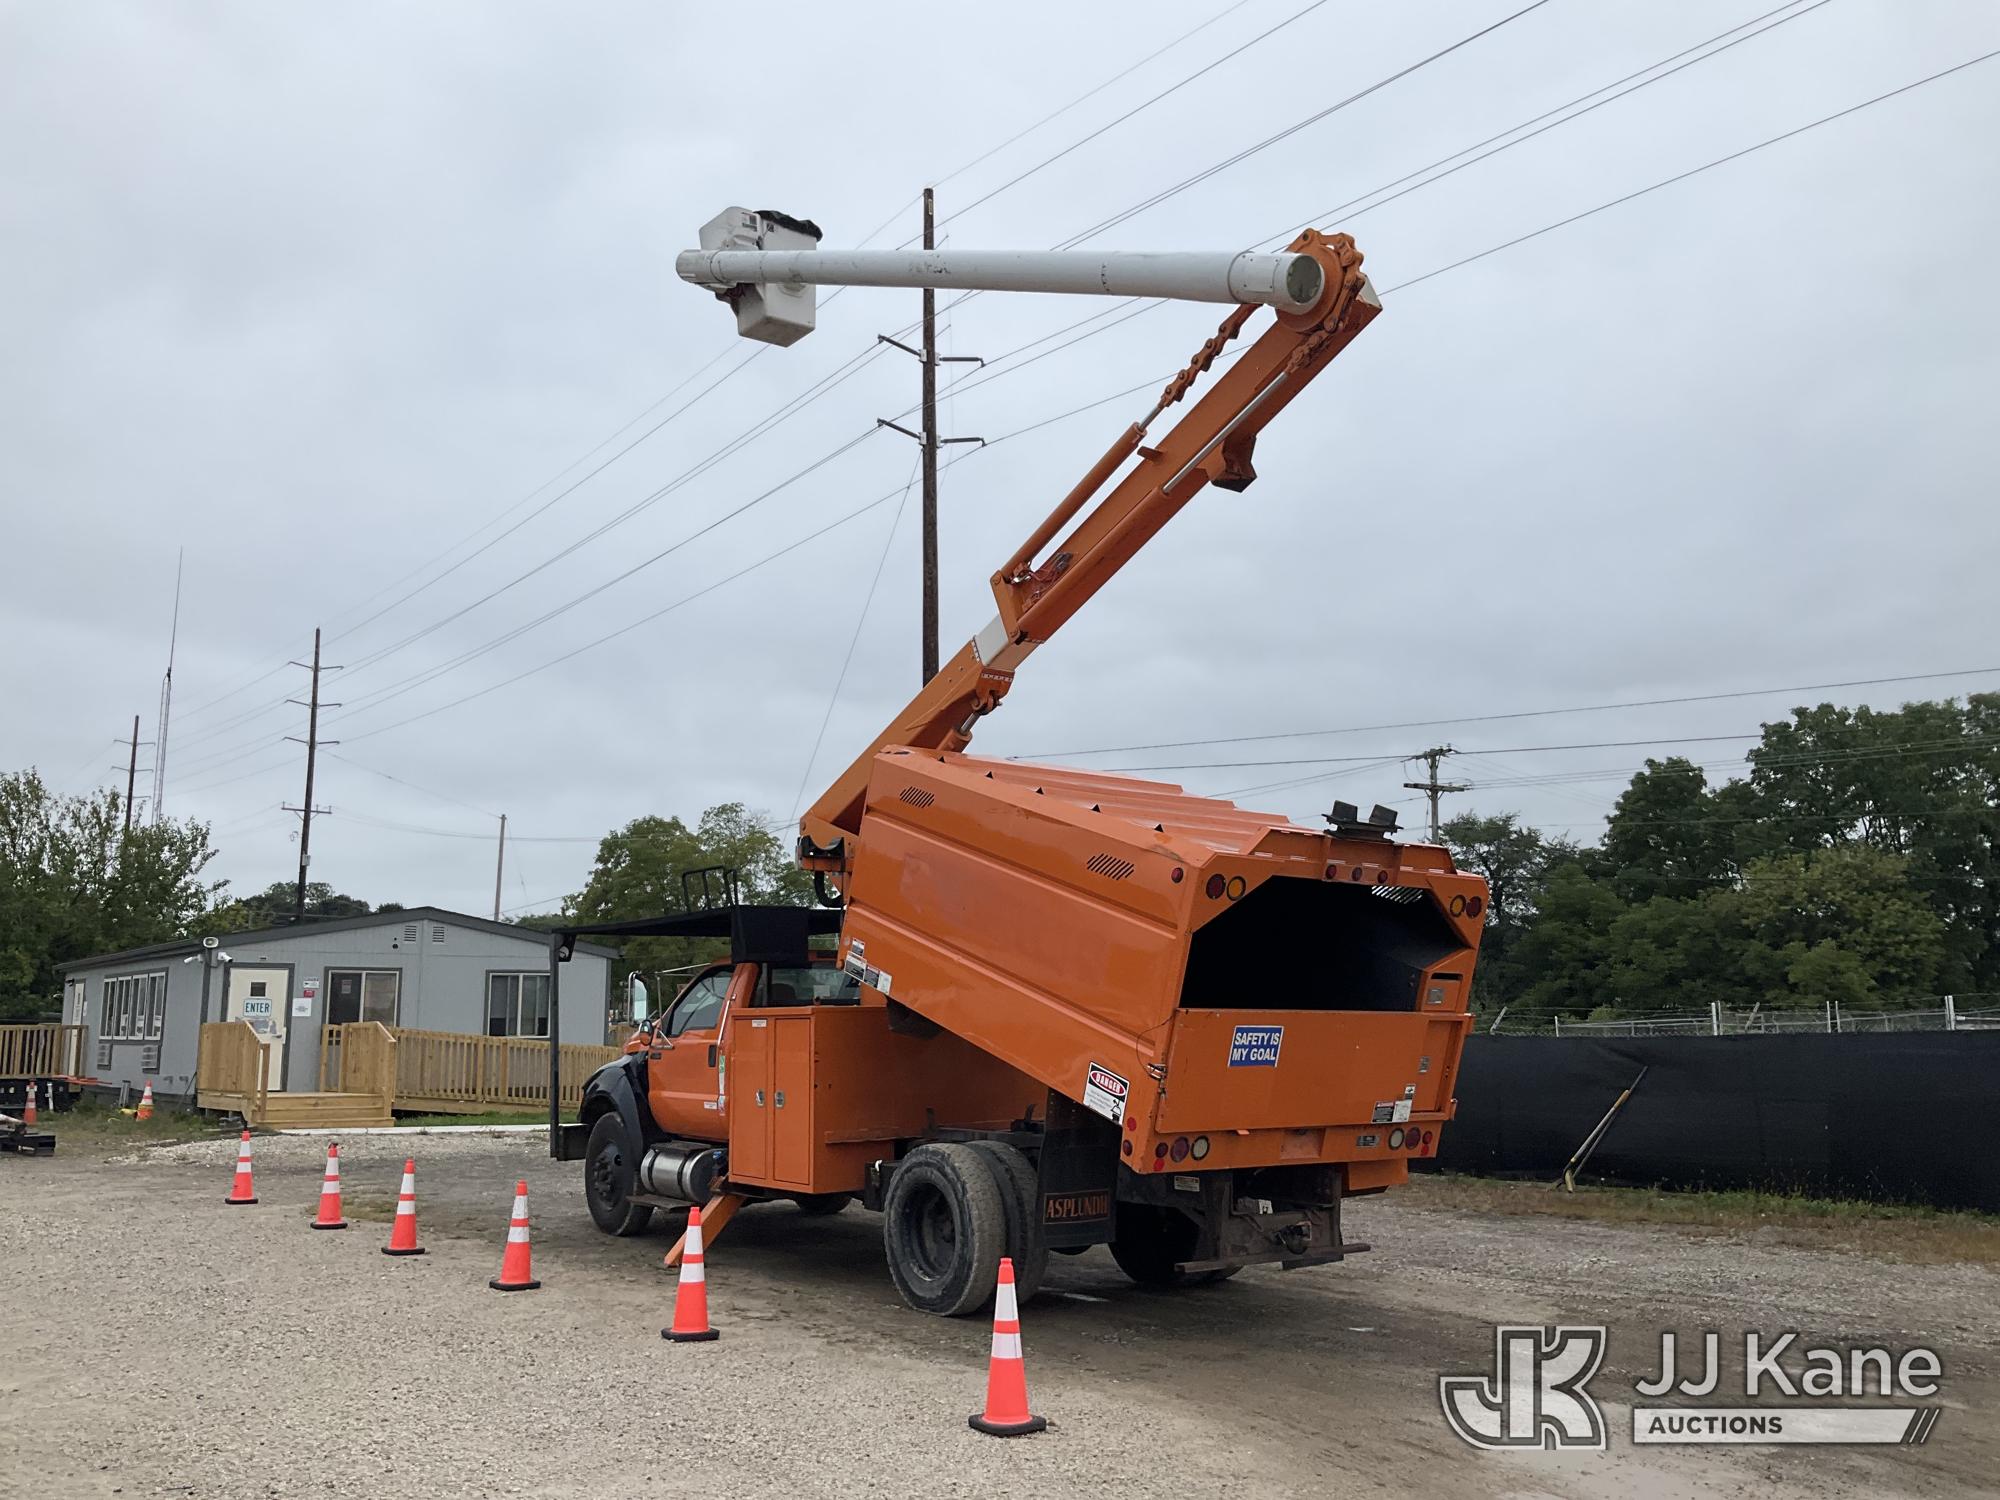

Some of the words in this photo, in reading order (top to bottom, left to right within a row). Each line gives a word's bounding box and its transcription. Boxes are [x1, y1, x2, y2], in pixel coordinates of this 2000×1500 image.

[245, 1003, 270, 1013] ENTER
[1235, 1033, 1270, 1045] SAFETY
[1270, 1033, 1280, 1045] IS
[1232, 1048, 1248, 1060] MY
[1250, 1048, 1276, 1061] GOAL
[1095, 1072, 1121, 1094] DANGER
